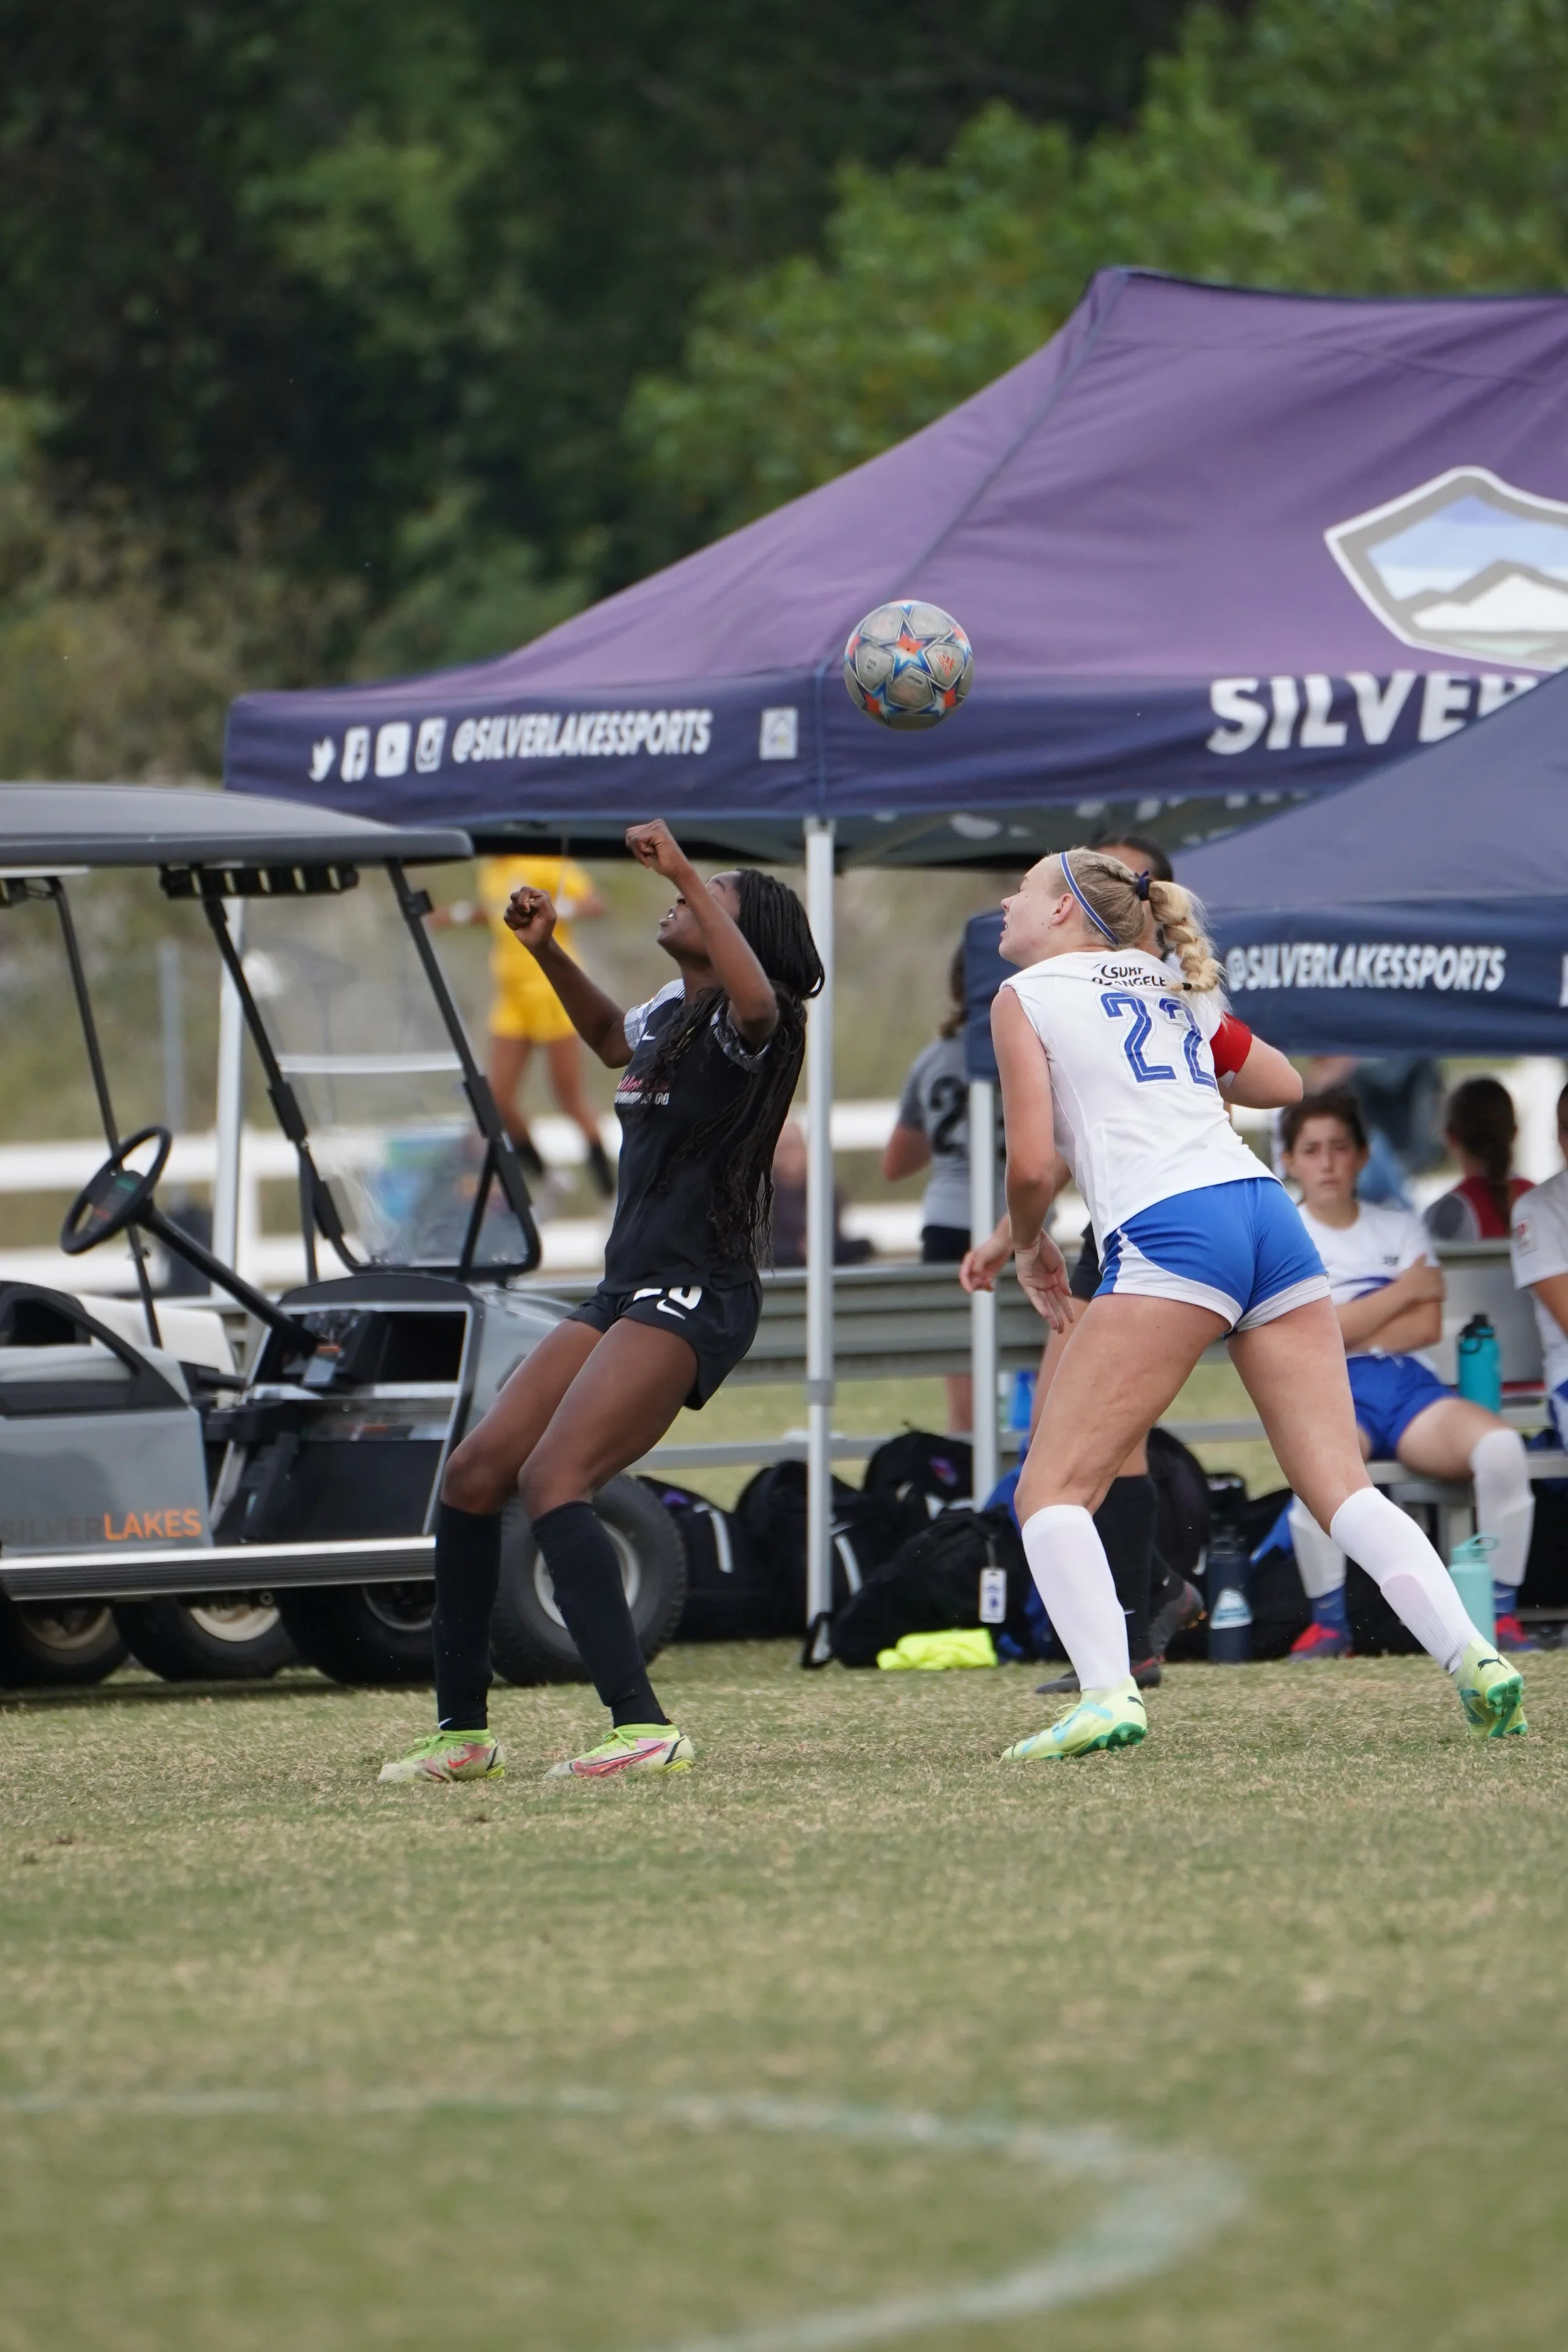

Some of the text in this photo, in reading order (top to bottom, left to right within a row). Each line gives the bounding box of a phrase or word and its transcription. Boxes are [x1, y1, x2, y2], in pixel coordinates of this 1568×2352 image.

[452, 709, 713, 763] @SILVERLAKESSPORTS
[1227, 943, 1507, 992] @SILVERLAKESSPORTS
[1100, 991, 1219, 1091] 22
